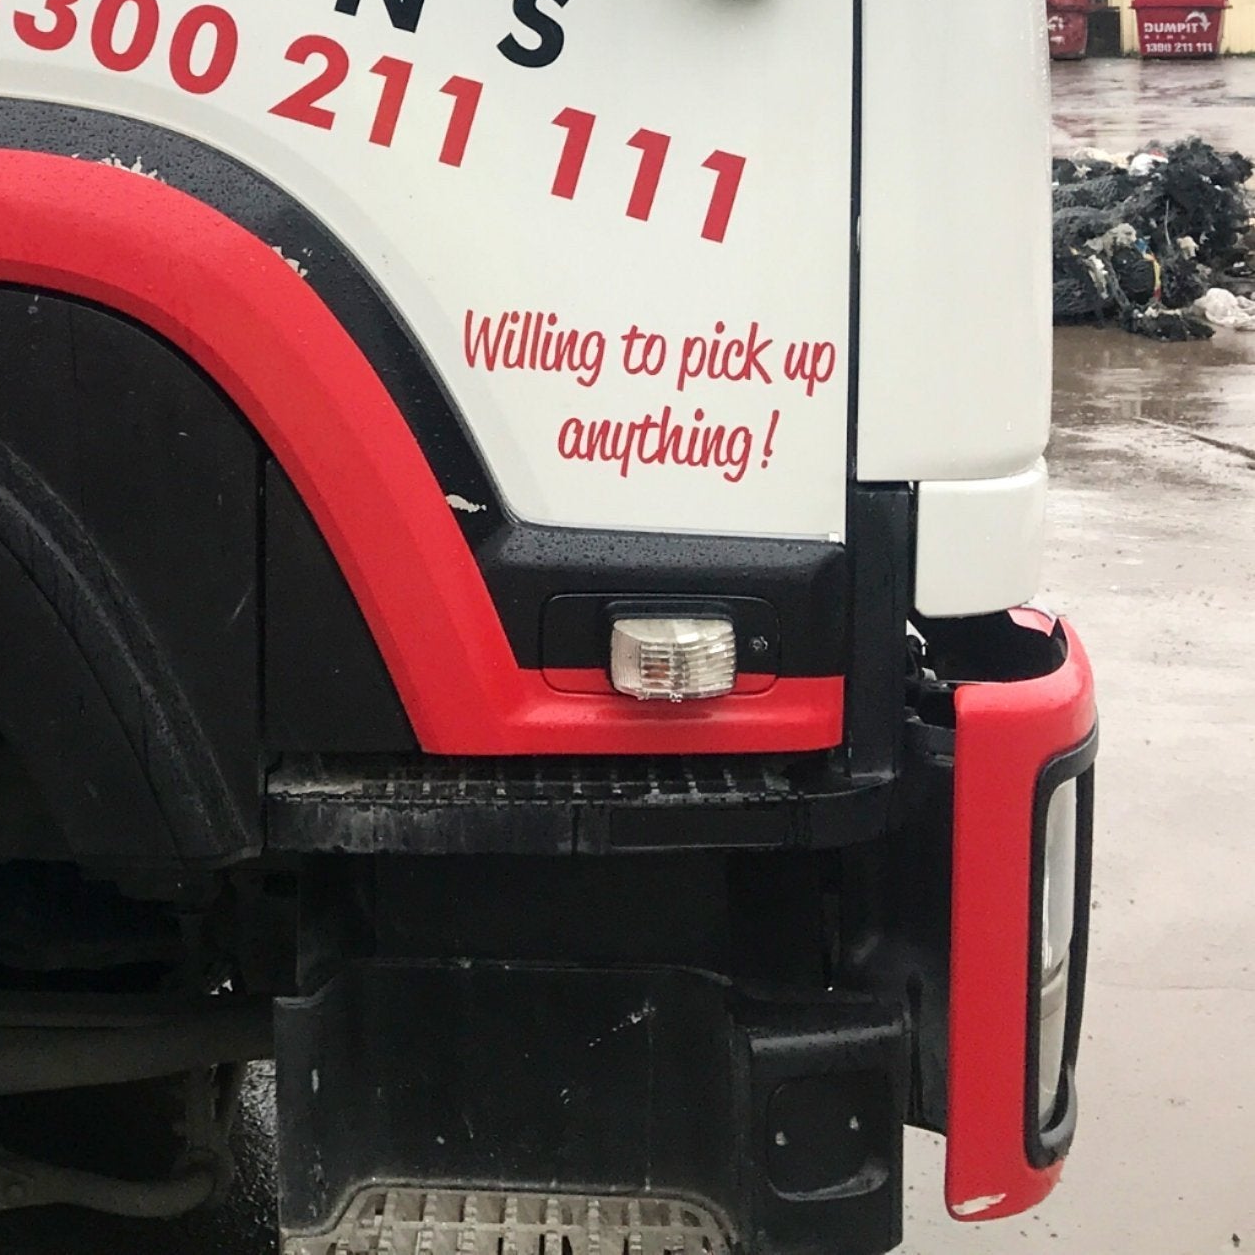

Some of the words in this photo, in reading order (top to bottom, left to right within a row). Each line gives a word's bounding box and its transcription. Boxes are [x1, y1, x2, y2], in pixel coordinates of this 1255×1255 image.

[1143, 22, 1199, 34] DUMPIT
[268, 34, 485, 168] 211
[549, 106, 748, 244] 111
[463, 309, 607, 388] Willing
[620, 324, 667, 377] to
[676, 320, 774, 392] pick
[783, 341, 837, 398] up
[557, 405, 781, 484] anything!
